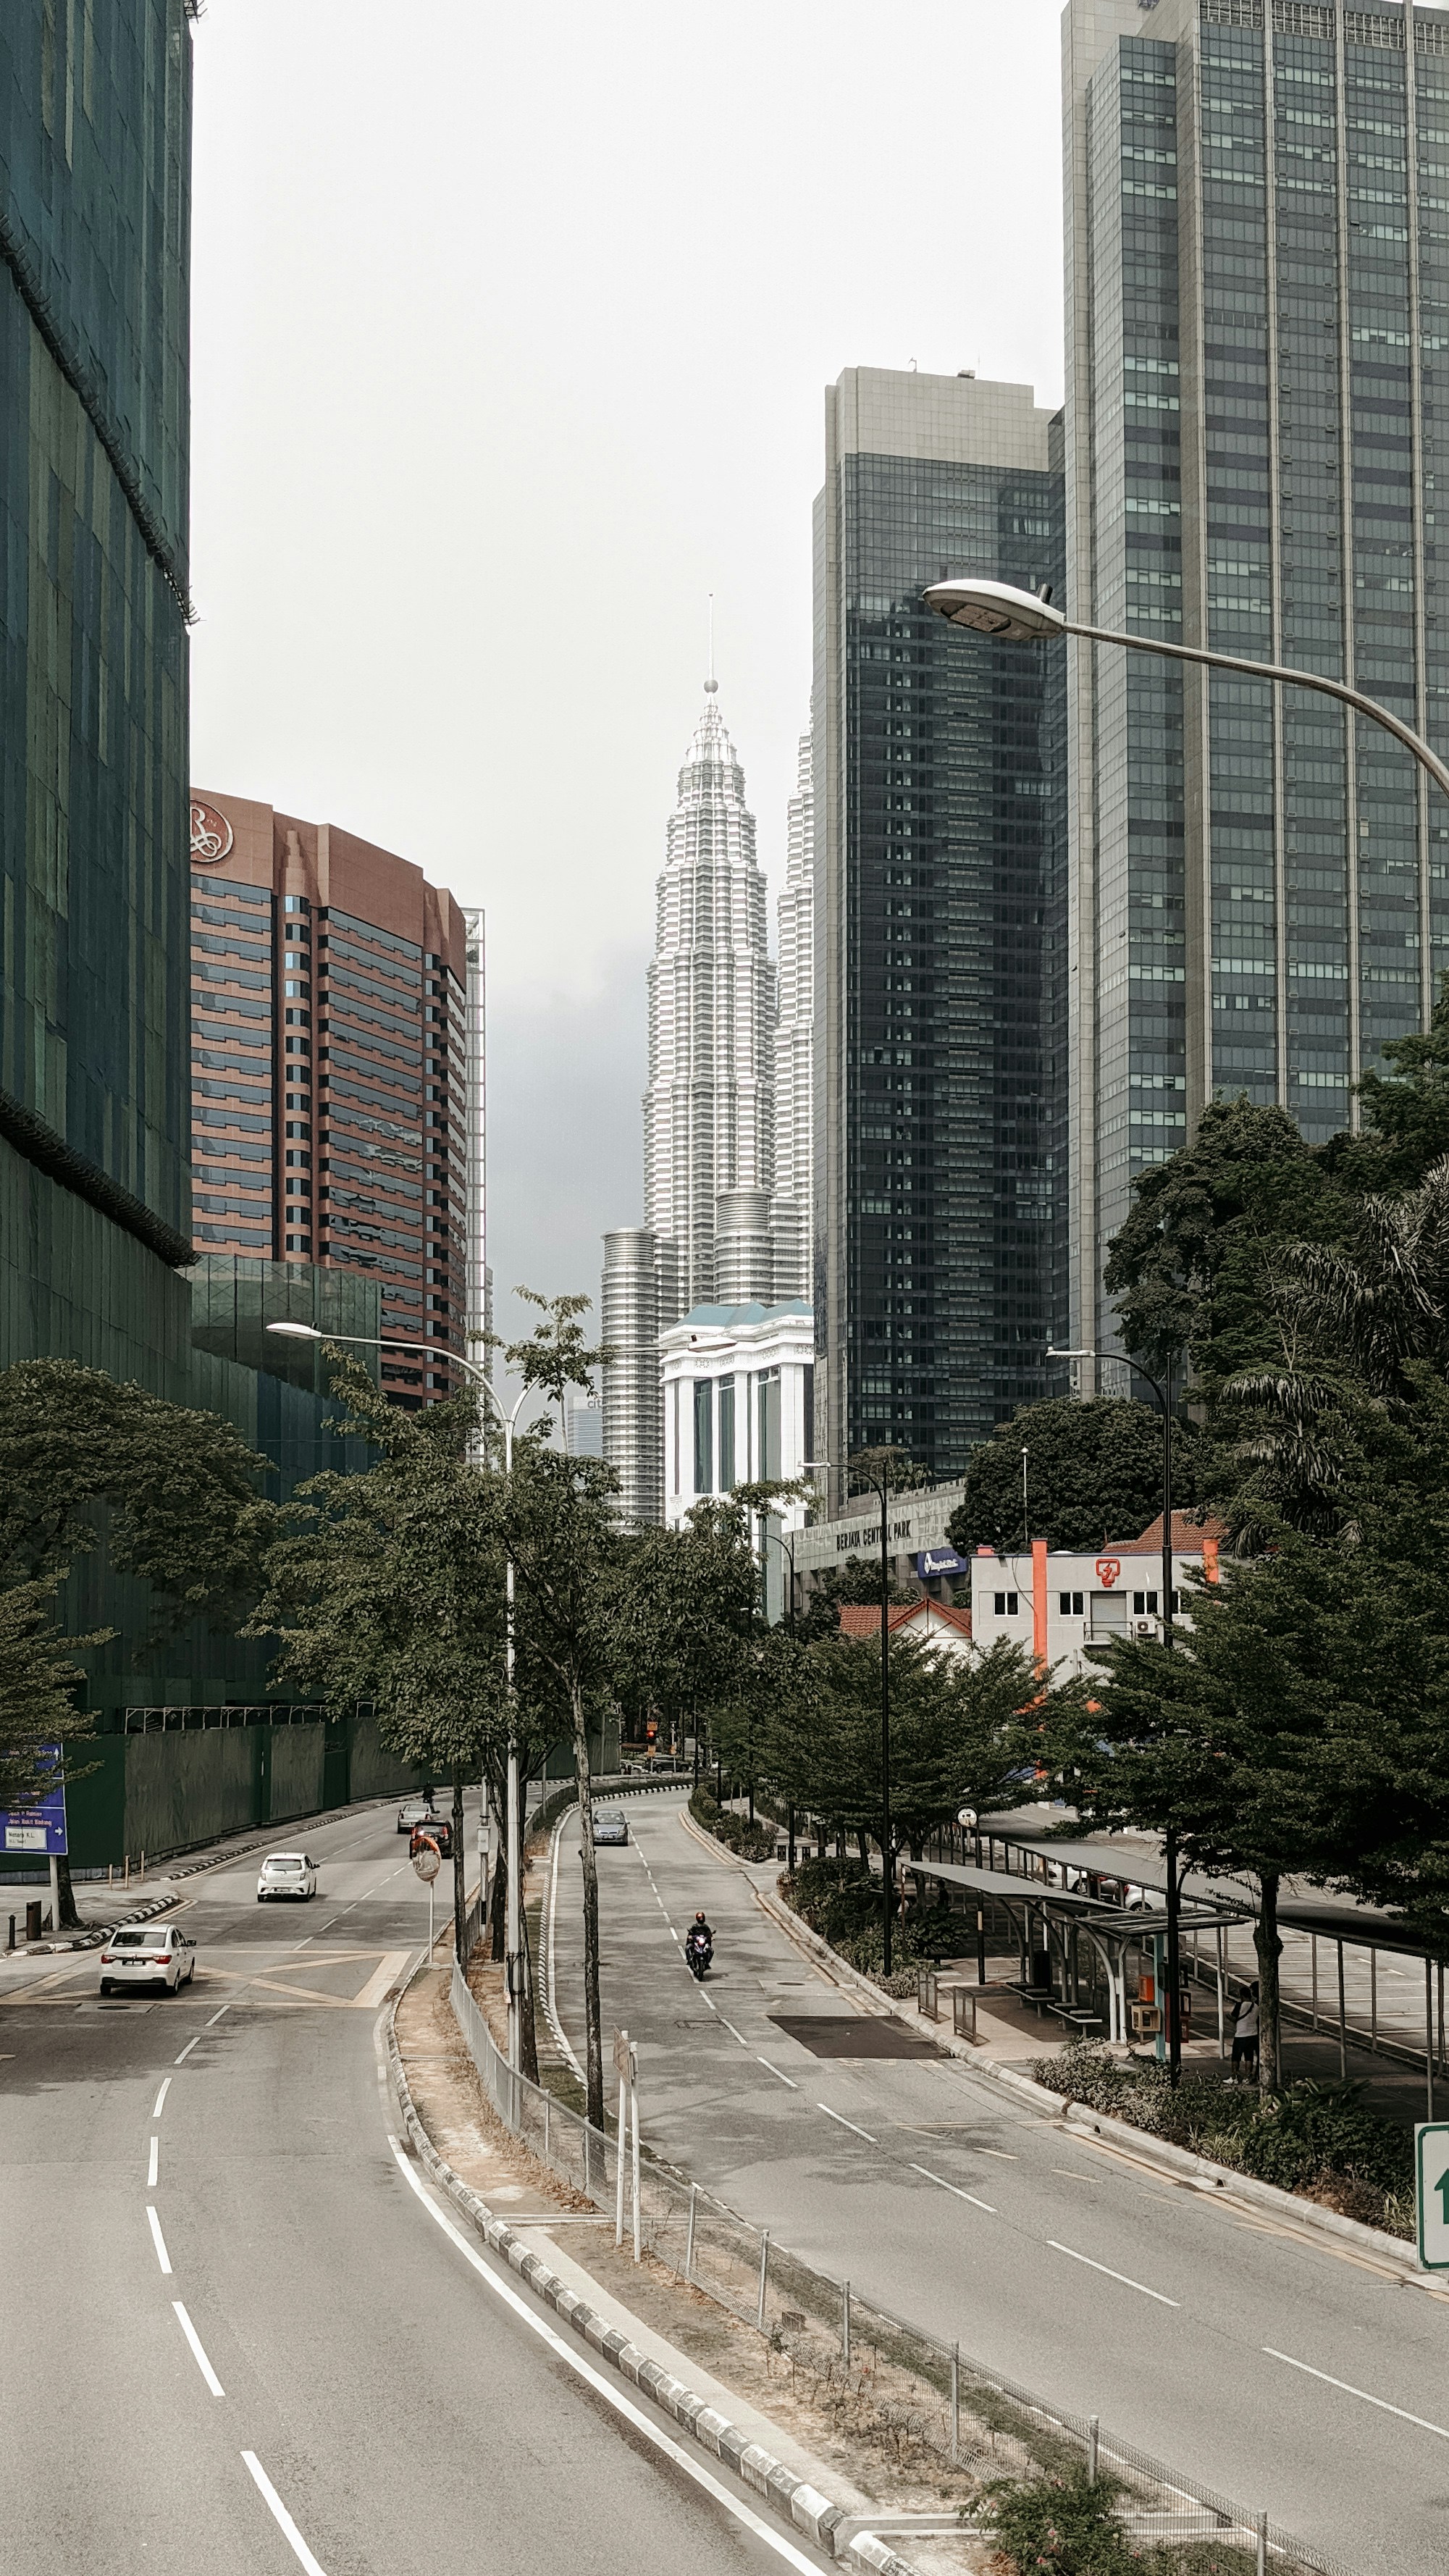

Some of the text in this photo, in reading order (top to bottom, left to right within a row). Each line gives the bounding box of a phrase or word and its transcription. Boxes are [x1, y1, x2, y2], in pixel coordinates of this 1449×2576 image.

[836, 1520, 911, 1551] BERJAYA CENTRL PARK
